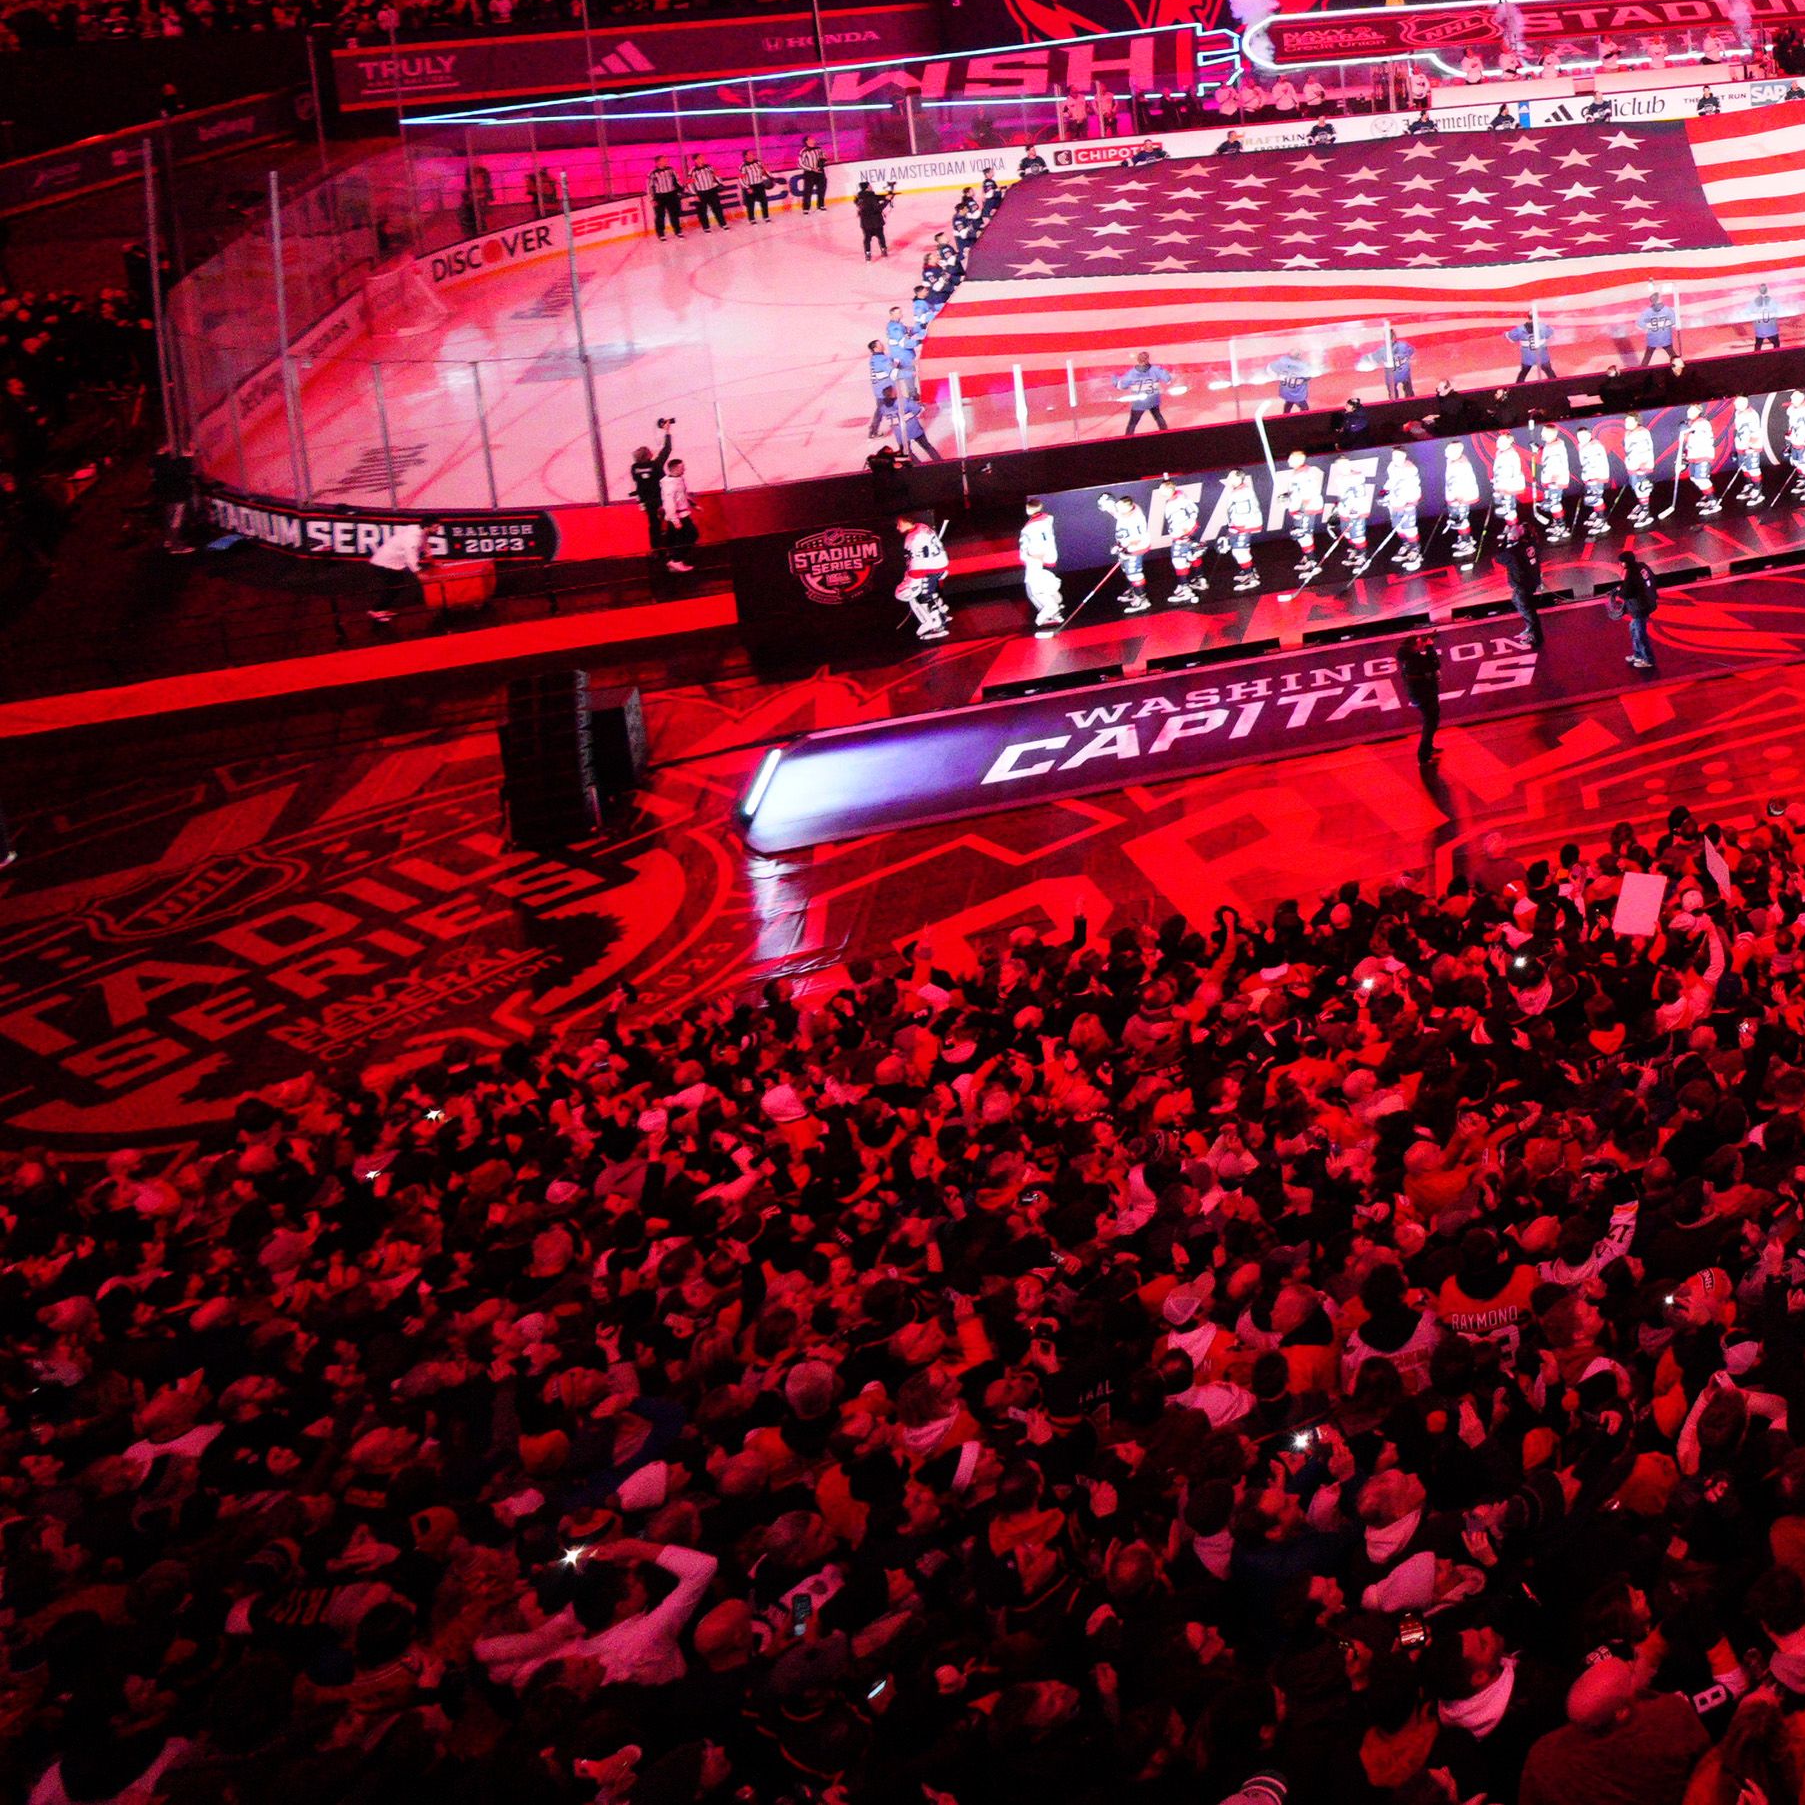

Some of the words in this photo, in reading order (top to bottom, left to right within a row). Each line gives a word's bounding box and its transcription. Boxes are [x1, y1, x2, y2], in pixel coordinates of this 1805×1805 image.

[783, 29, 881, 50] HONDA
[1424, 16, 1483, 41] NHL
[357, 55, 457, 79] TRULY
[829, 37, 1157, 101] WSH
[1728, 92, 1747, 101] RUN
[1751, 82, 1788, 105] SAP
[1079, 146, 1141, 162] CHIPOT
[860, 167, 888, 183] NEW
[890, 161, 967, 180] AMSTERDAM
[969, 156, 1006, 174] VODKA
[572, 206, 638, 237] ESPN
[432, 225, 553, 282] DISCOVER
[452, 524, 534, 537] RALEIGH
[465, 538, 525, 553] 2023
[793, 542, 879, 570] STADIUM
[811, 558, 864, 576] SERIES
[1066, 633, 1541, 729] WASHINGON
[979, 651, 1538, 785] CAPITAS
[151, 861, 245, 927] NHL
[0, 835, 507, 1055] TADIU
[67, 864, 606, 1088] SERIES
[1450, 1306, 1519, 1333] RAYMOND
